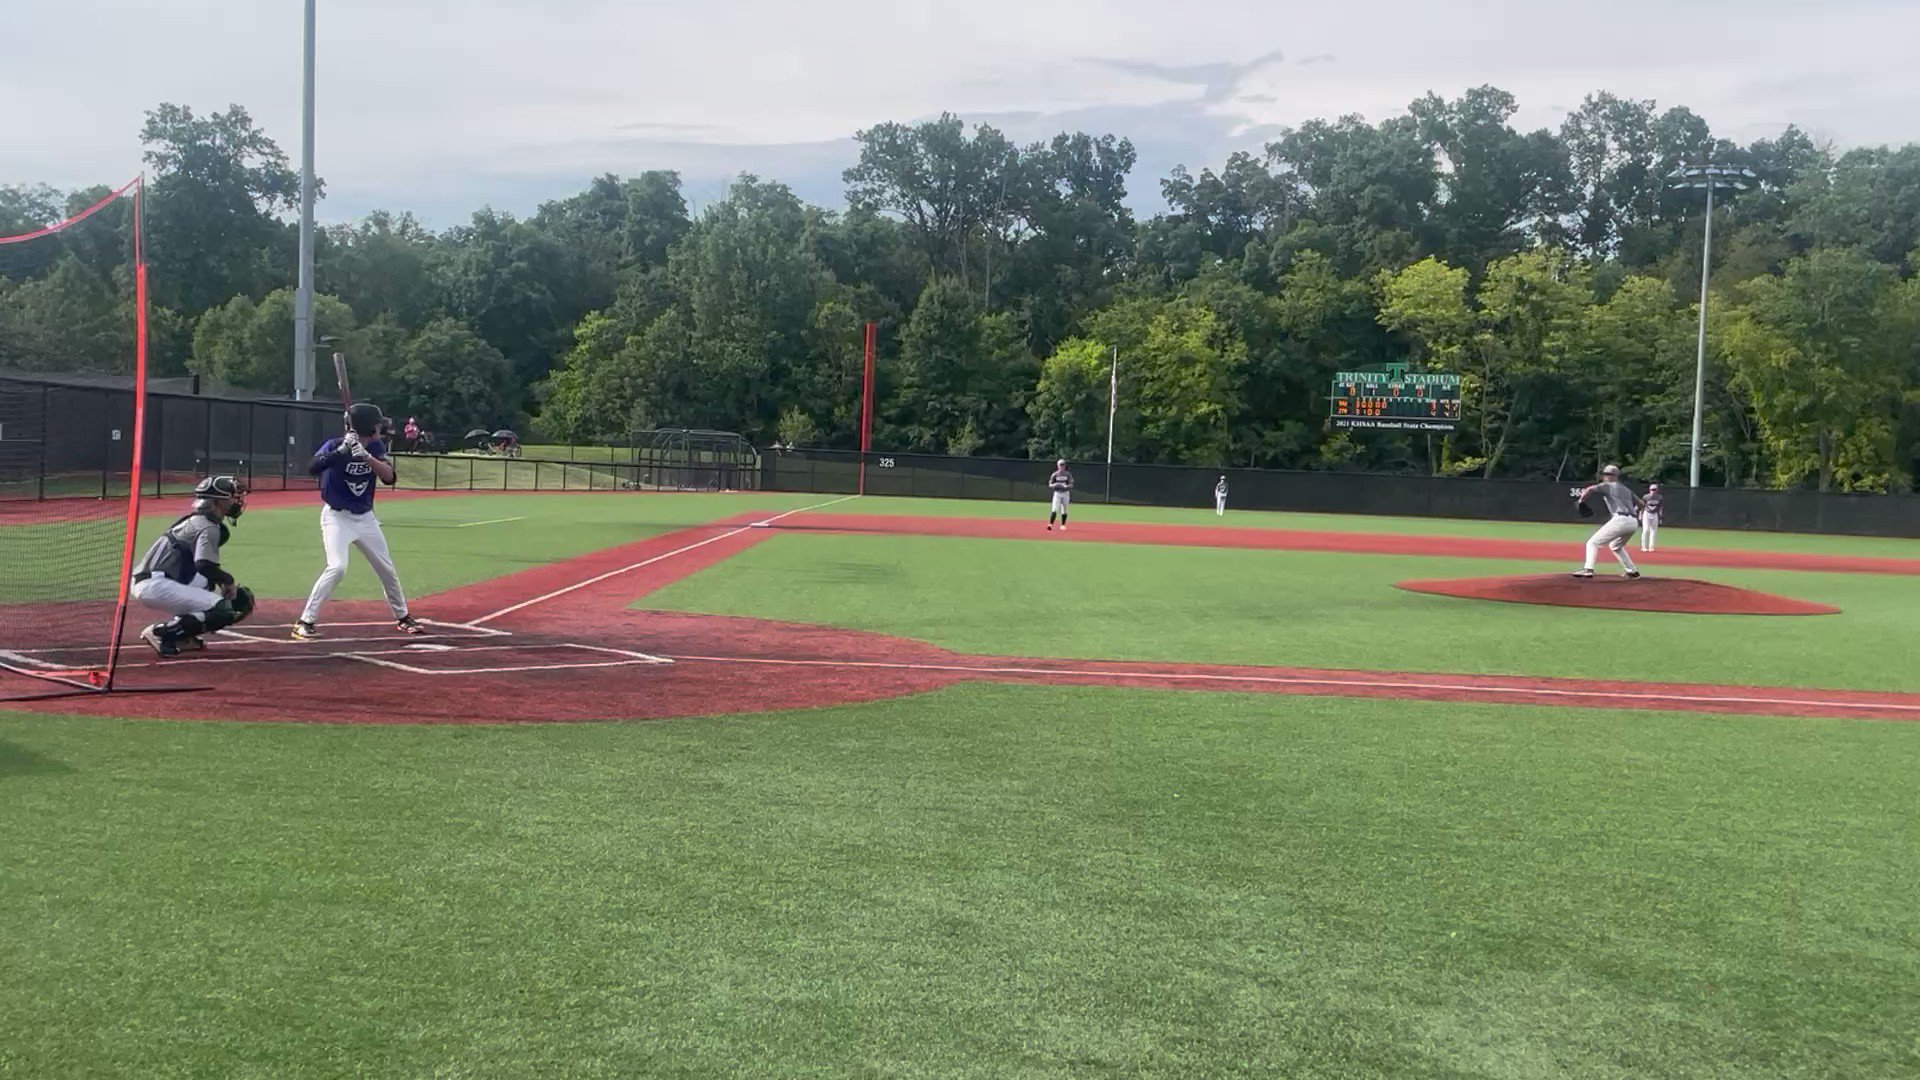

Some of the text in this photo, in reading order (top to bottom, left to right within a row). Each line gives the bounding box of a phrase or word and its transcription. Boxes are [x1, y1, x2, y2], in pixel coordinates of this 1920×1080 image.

[1337, 373, 1459, 384] TRINITY STADIUM
[879, 457, 894, 467] 325
